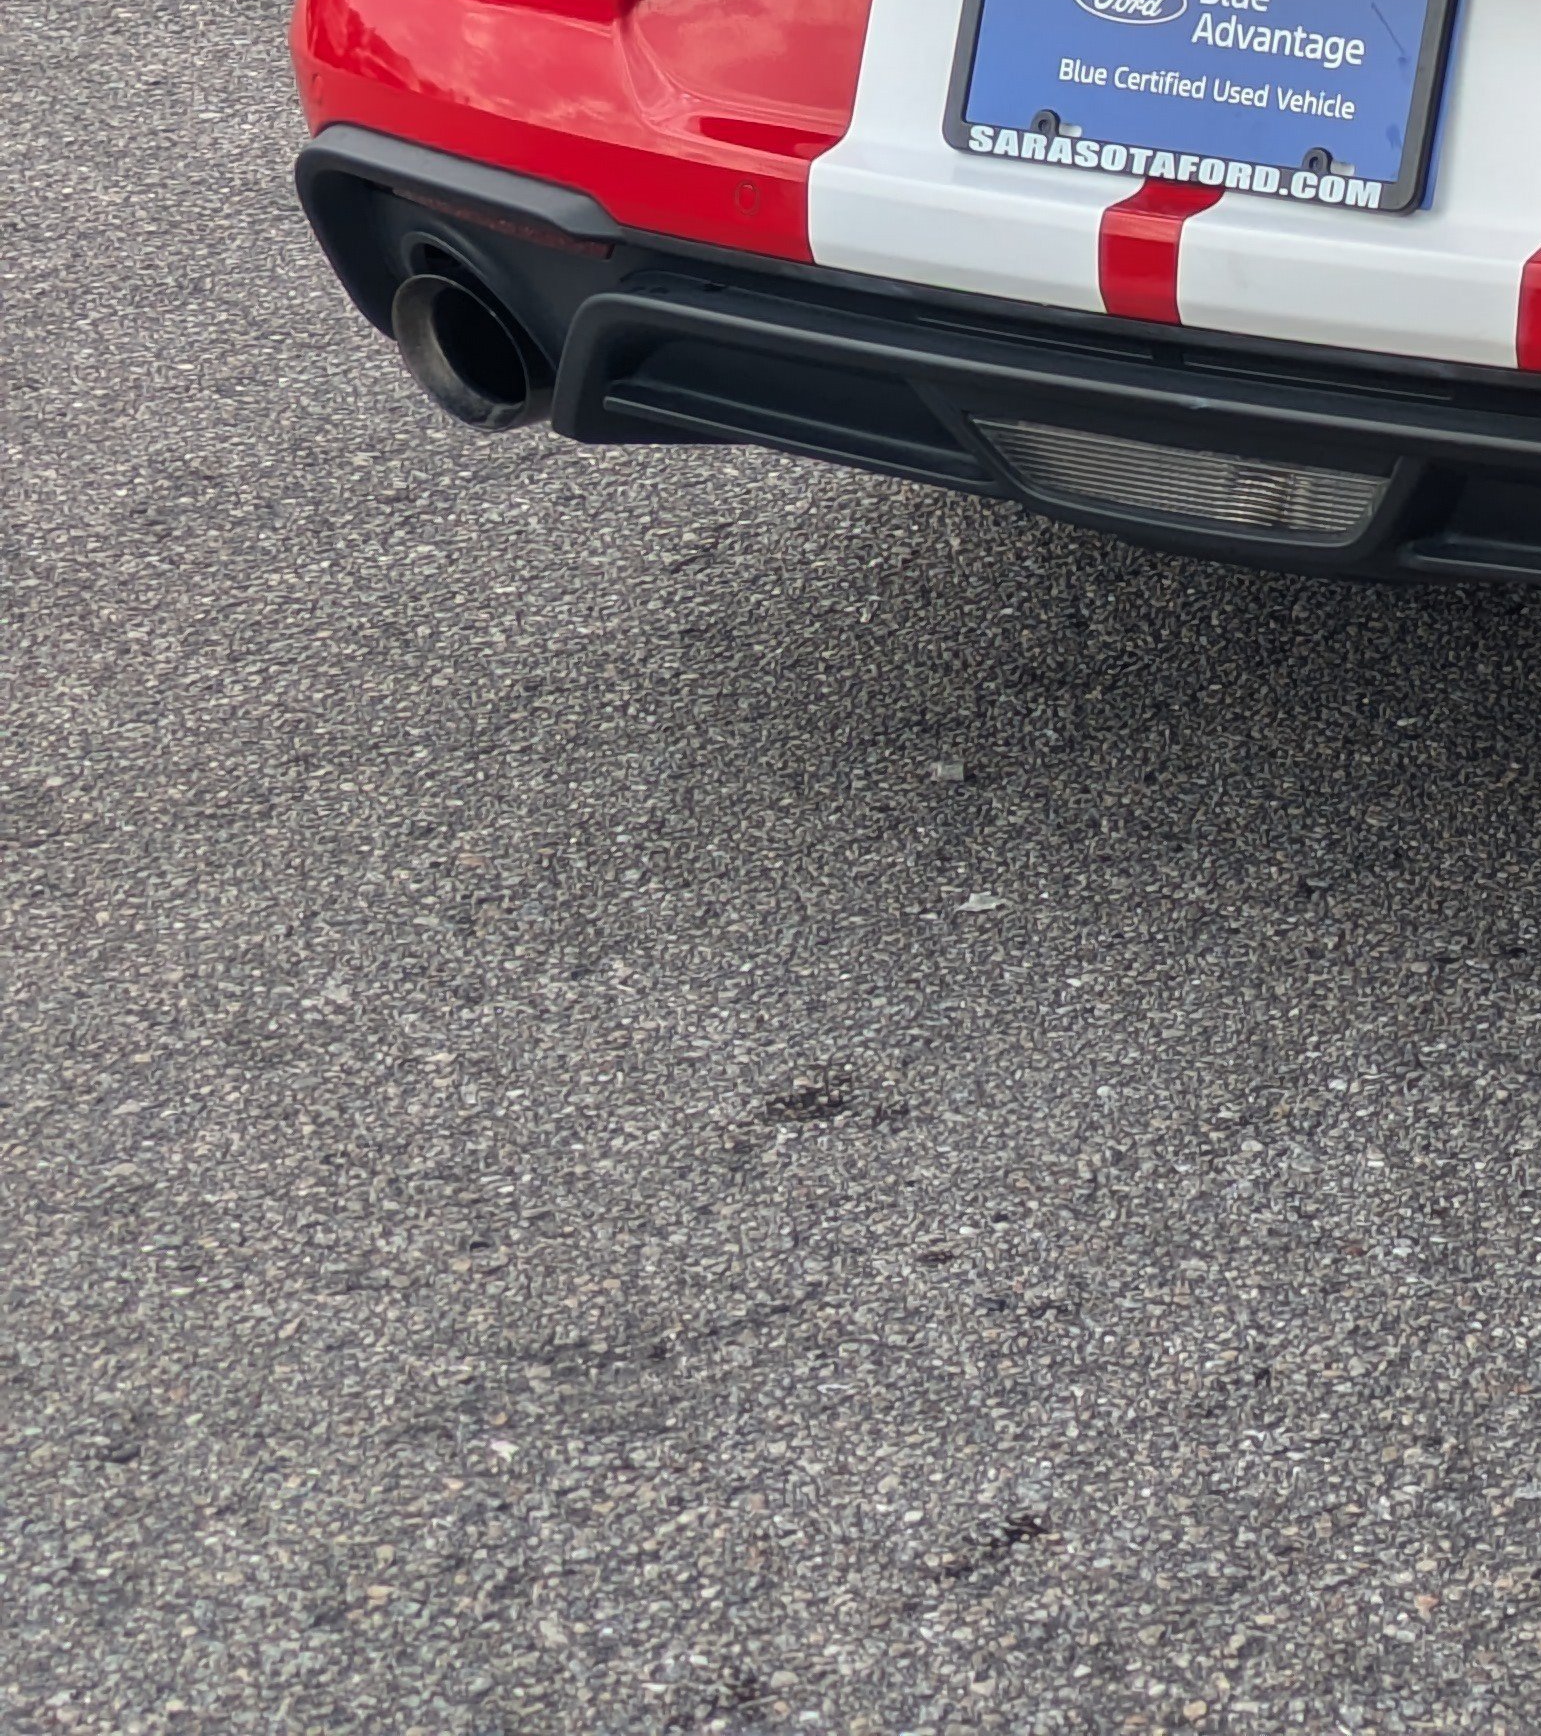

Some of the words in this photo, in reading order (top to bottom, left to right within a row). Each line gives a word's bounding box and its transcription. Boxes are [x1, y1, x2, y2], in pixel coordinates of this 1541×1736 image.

[1191, 12, 1365, 69] Advantage
[1058, 57, 1107, 85] Blue
[1114, 66, 1206, 99] Certified
[1213, 78, 1269, 107] Used
[1277, 86, 1355, 119] Vehicle
[968, 124, 1382, 209] SARASOTAFORD.COM
